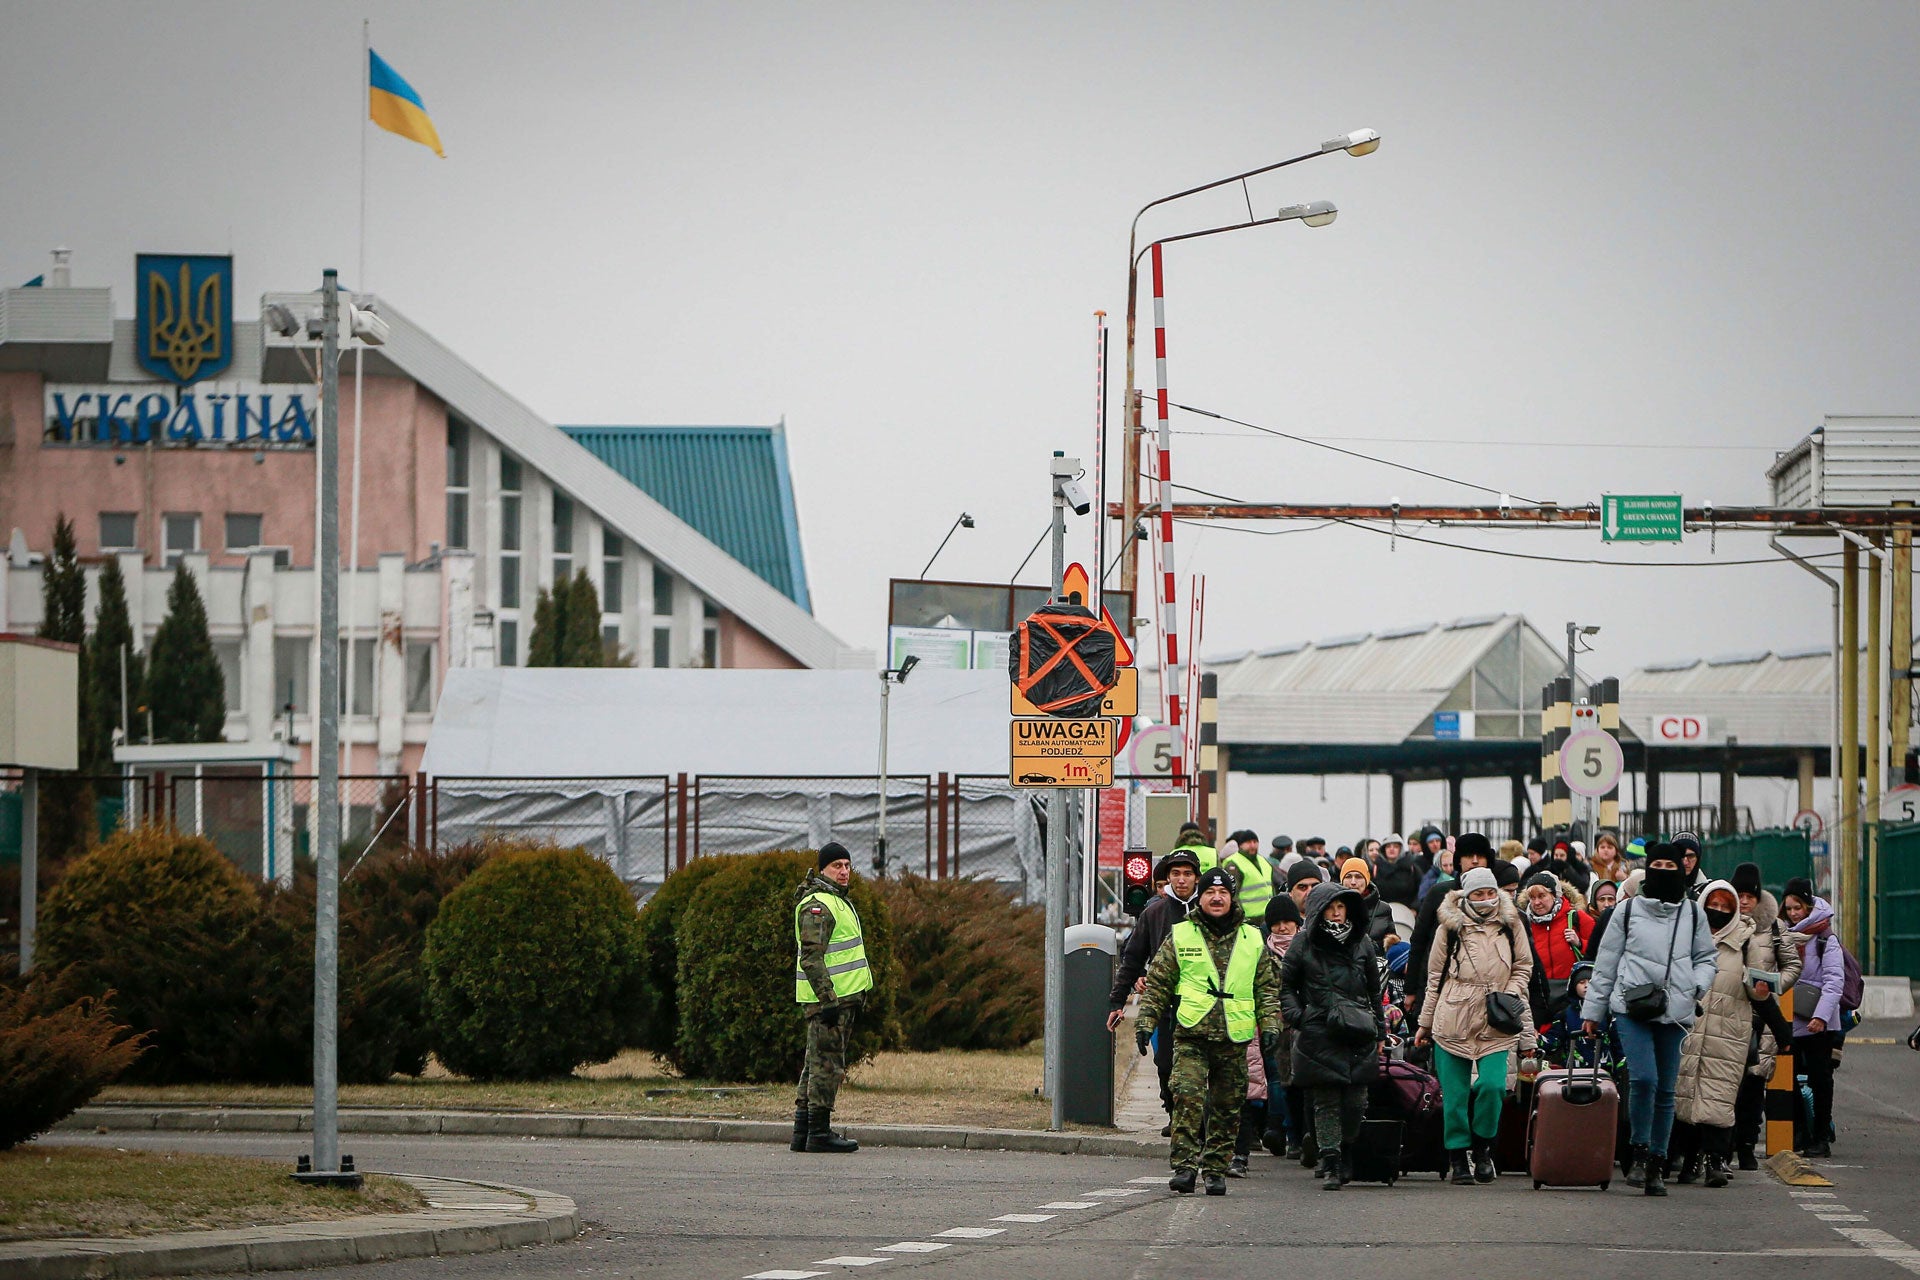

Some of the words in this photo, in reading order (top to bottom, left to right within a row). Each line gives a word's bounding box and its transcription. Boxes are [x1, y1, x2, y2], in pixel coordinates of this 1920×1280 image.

[52, 392, 312, 441] УКРАЇНА
[1623, 513, 1645, 521] GREEN
[1647, 513, 1677, 521] CHANNEL
[1623, 527, 1659, 535] ZIELONY
[1661, 527, 1677, 535] PAS
[1019, 722, 1105, 739] UWAGA!
[1661, 717, 1700, 739] CD
[1153, 742, 1171, 772] 5
[1583, 747, 1602, 778] 5
[1063, 763, 1088, 777] 1m
[1902, 801, 1915, 821] 5
